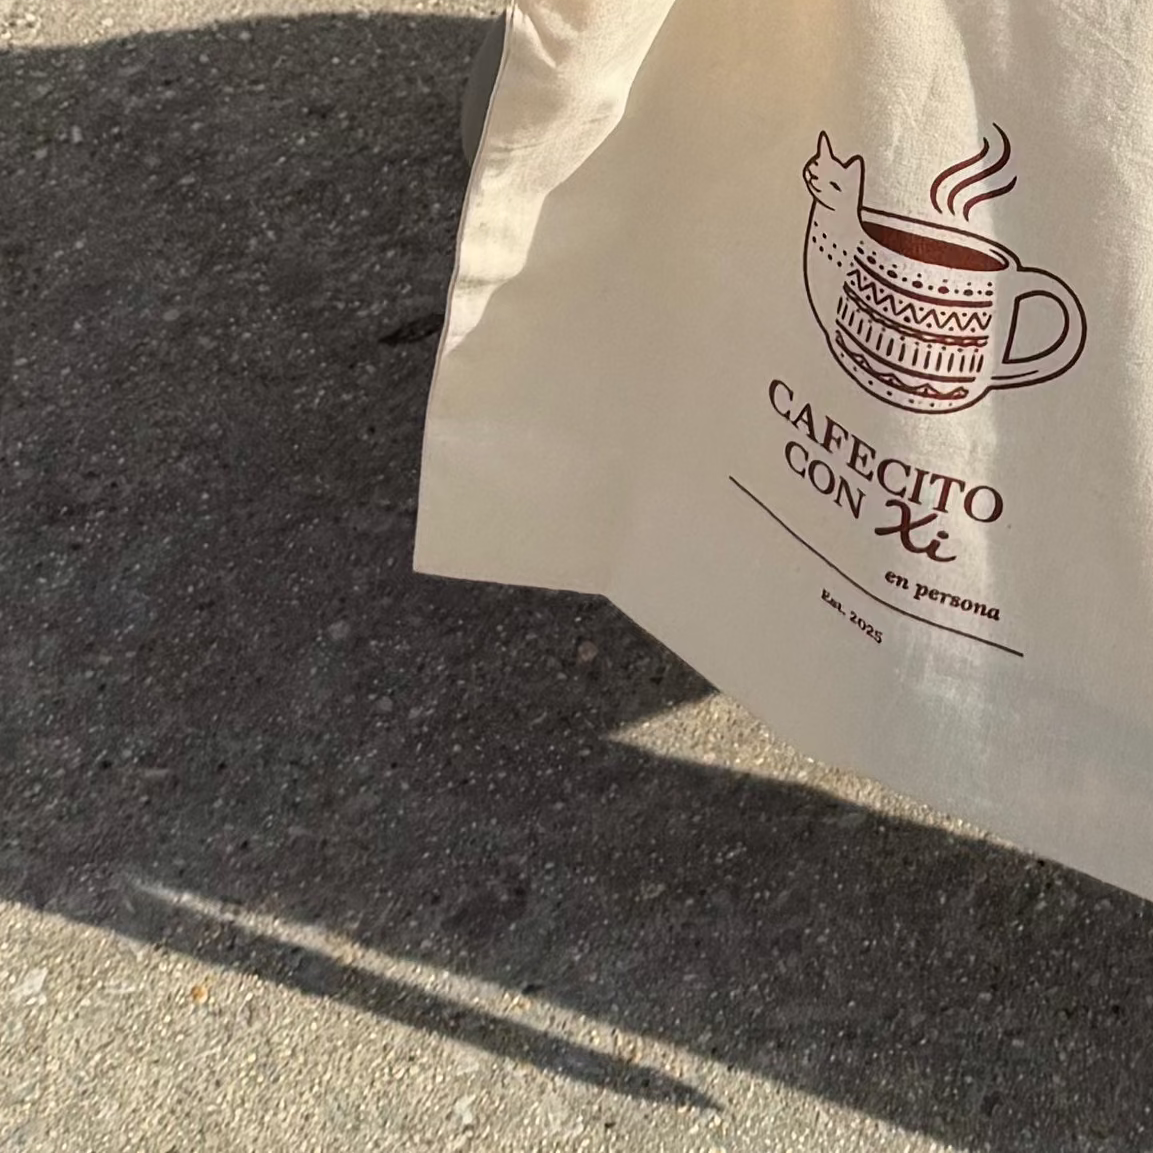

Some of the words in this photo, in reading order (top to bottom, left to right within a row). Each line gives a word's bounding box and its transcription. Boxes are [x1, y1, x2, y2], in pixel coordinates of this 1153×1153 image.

[768, 379, 1004, 523] CAFECITO
[784, 441, 866, 520] CON
[874, 499, 957, 562] Xi
[849, 610, 883, 644] 2025
[884, 570, 909, 590] en
[912, 582, 1001, 621] persona
